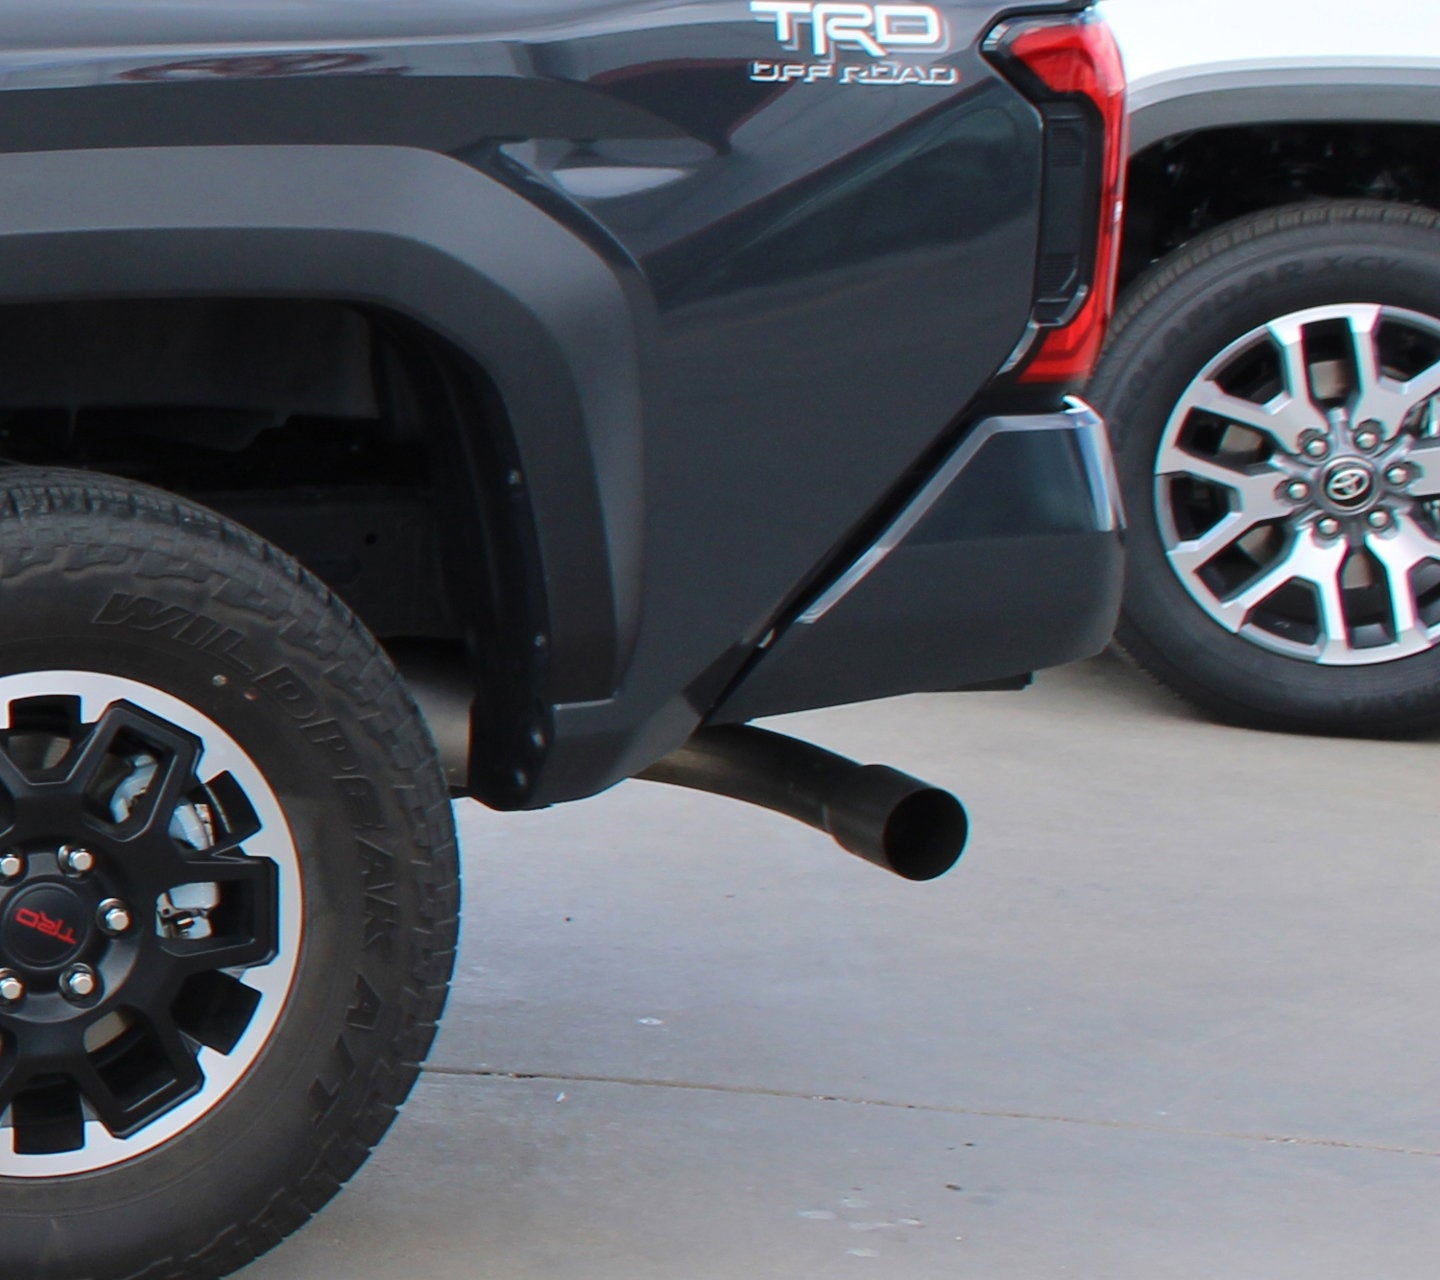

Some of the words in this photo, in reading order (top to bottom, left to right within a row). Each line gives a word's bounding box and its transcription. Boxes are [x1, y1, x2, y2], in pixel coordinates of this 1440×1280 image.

[749, 0, 941, 57] TRD
[749, 61, 832, 83] OFF
[837, 64, 962, 85] ROAD
[91, 592, 397, 951] WILDPEAK
[15, 907, 78, 946] TRD
